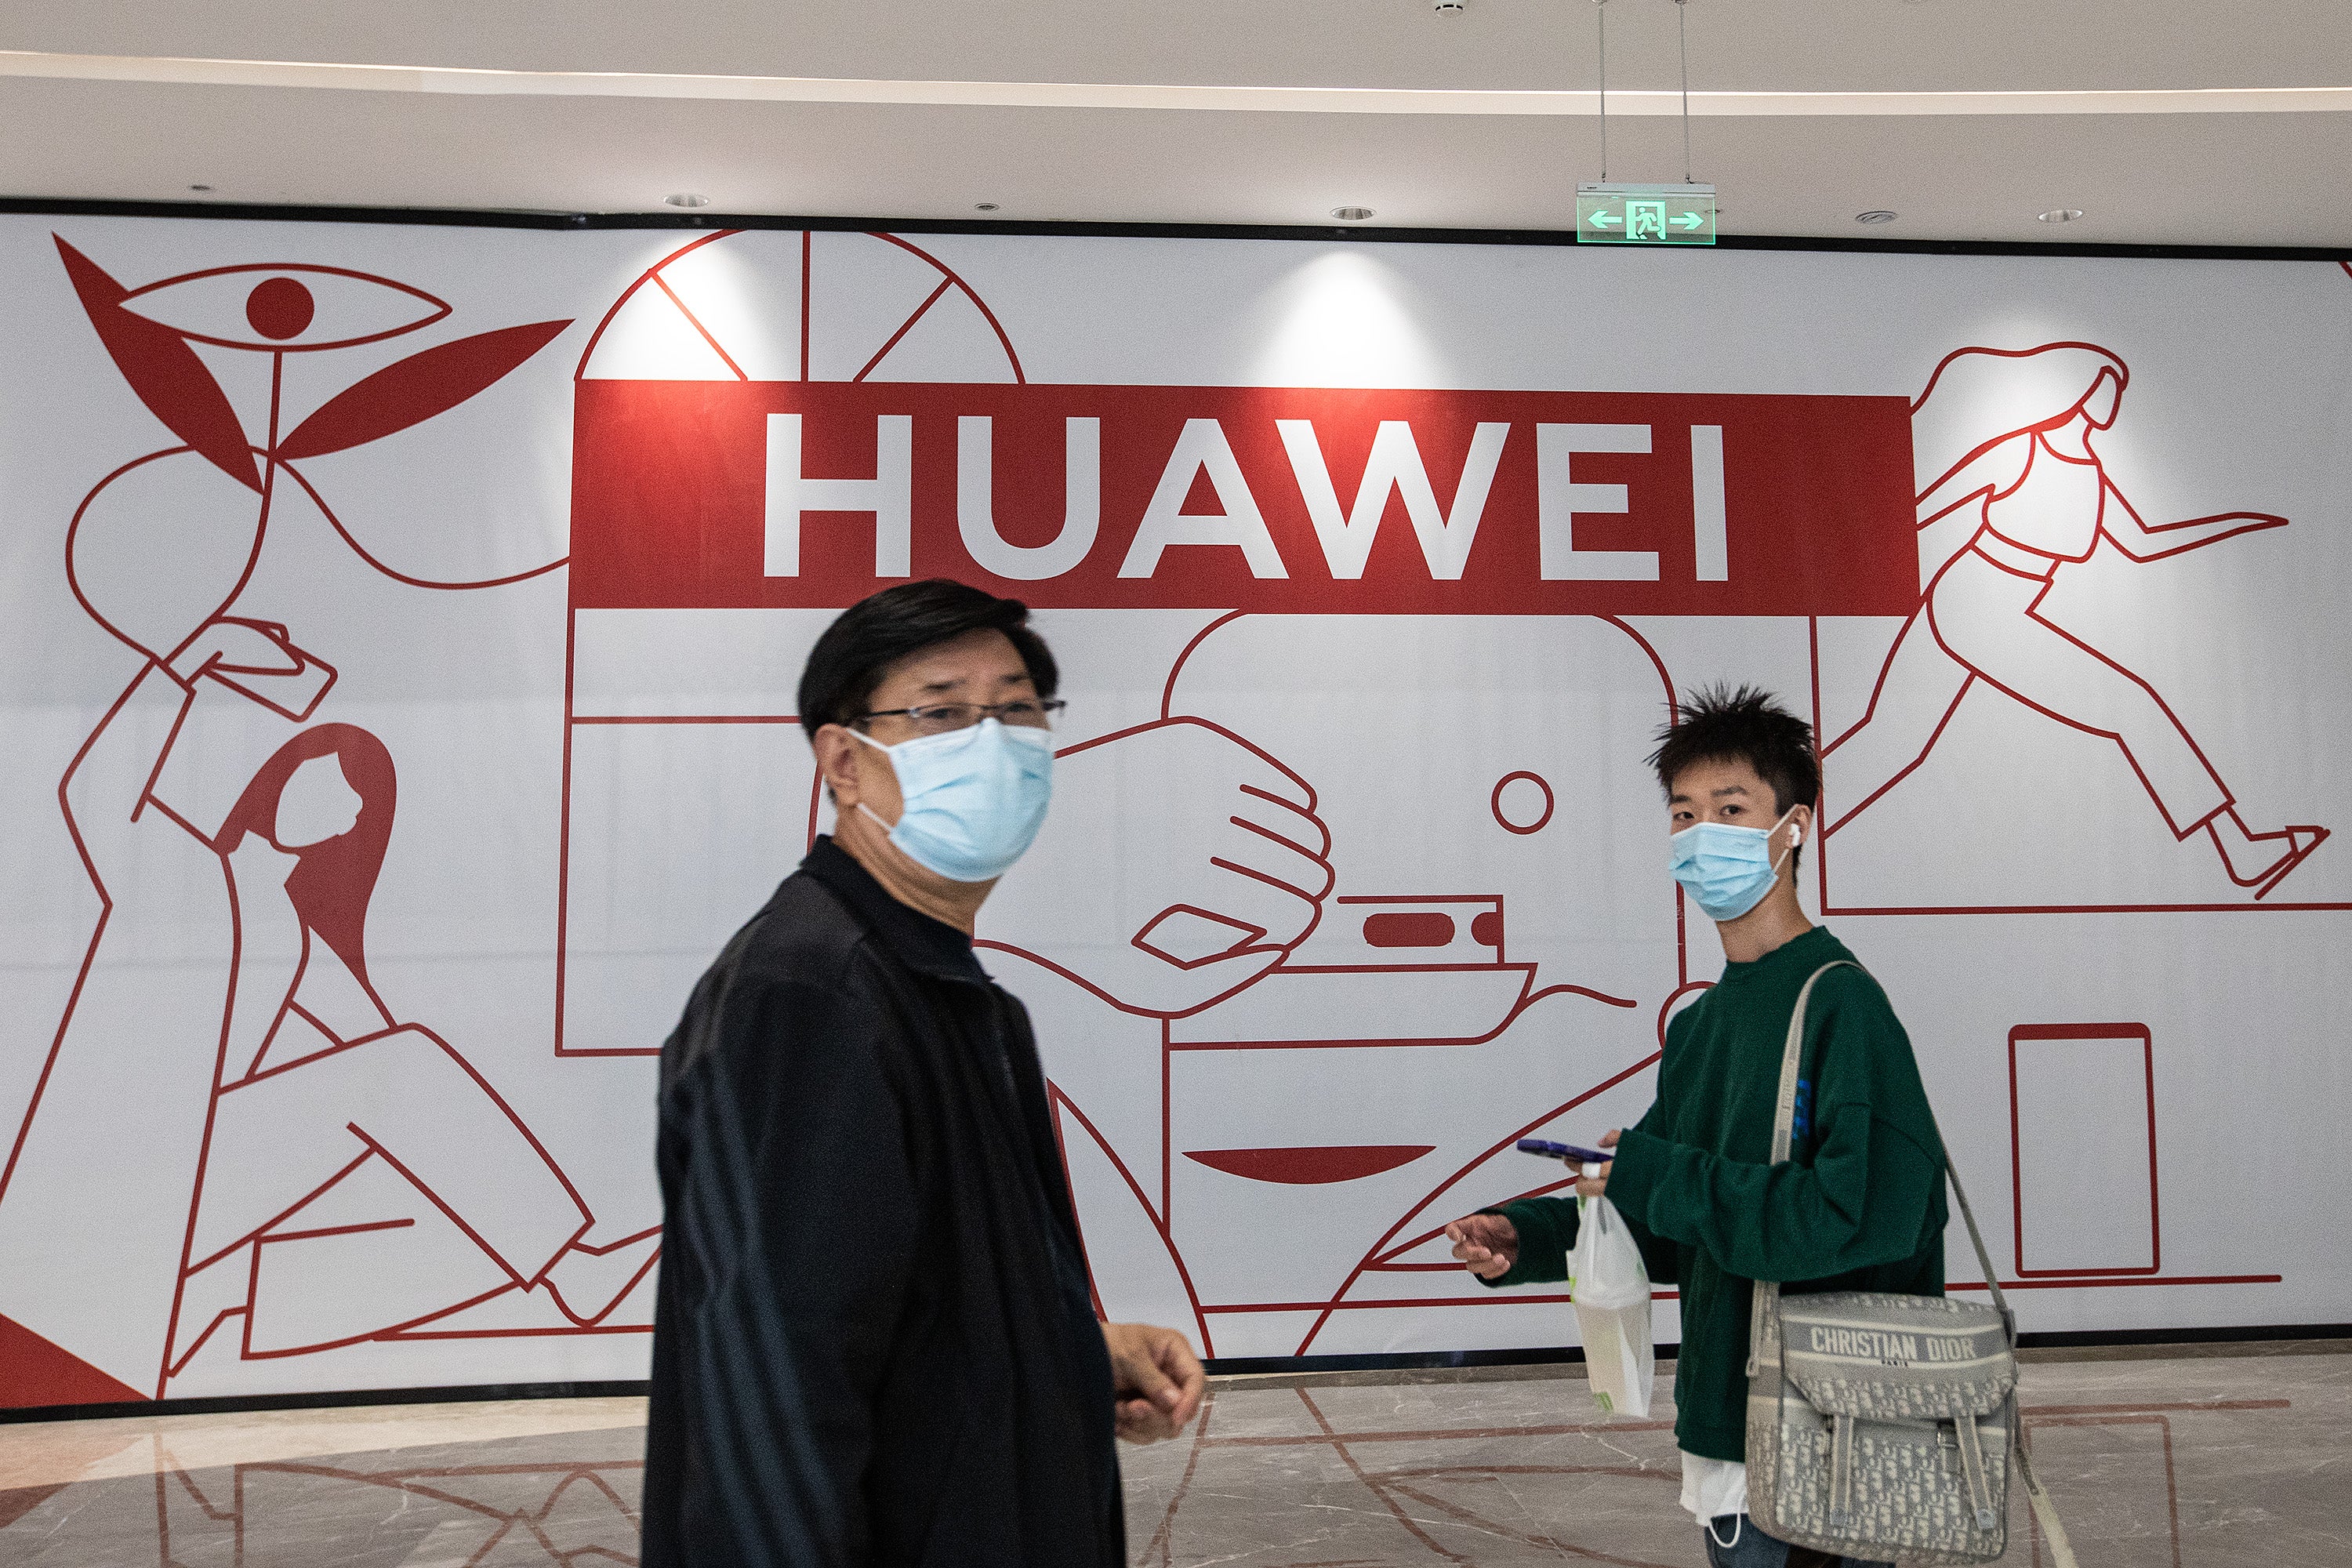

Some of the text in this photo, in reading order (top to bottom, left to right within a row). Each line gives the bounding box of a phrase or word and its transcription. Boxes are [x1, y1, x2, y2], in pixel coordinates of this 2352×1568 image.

[764, 412, 1729, 582] HUAWEI
[1810, 1327, 1976, 1361] CHRISTIAN DIOR
